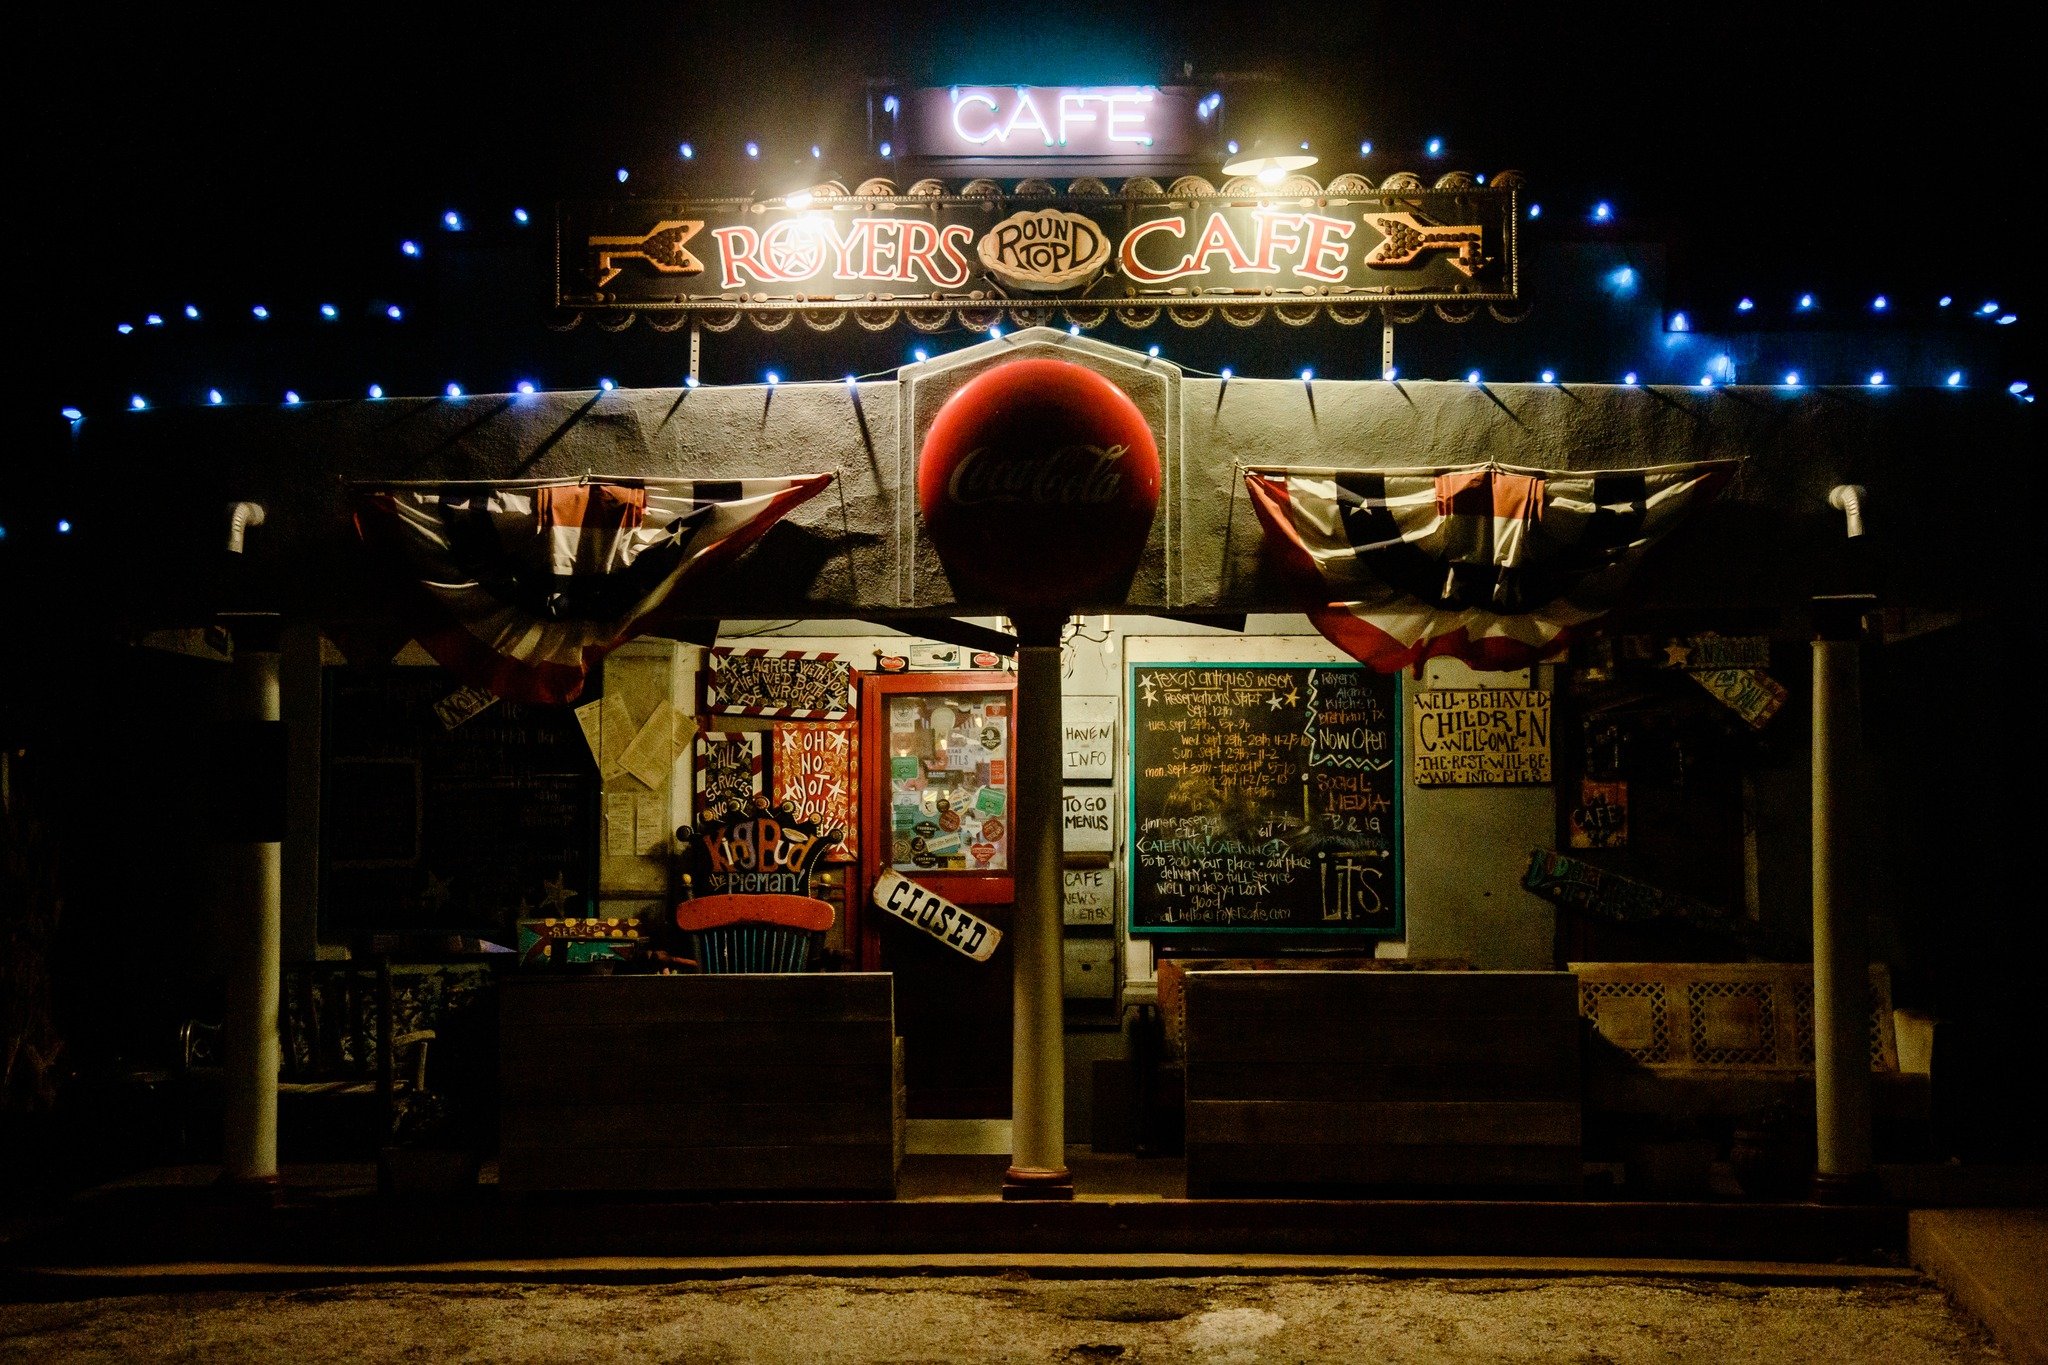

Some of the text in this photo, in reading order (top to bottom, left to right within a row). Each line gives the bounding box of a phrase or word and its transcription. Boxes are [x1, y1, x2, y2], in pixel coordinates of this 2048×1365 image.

[953, 94, 1153, 146] CAFE
[711, 218, 974, 289] ROYERS
[996, 217, 1099, 271] ROUND
[1118, 211, 1356, 284] CAFE
[1020, 242, 1071, 273] TOP
[753, 658, 796, 673] AGREE
[766, 684, 815, 710] WRONG
[1468, 691, 1547, 709] BEHAVED
[803, 731, 824, 752] OH
[1065, 725, 1110, 741] HAVEN
[1420, 708, 1548, 752] CHILDREN
[1442, 728, 1519, 752] WELCOME
[718, 744, 740, 769] ALL
[801, 753, 823, 775] NO
[1067, 751, 1107, 767] INFO
[1419, 754, 1545, 770] THE REST WILL BE
[706, 774, 753, 802] SERVICES
[794, 773, 831, 799] NOT
[1420, 770, 1456, 783] MADE
[1466, 770, 1495, 782] INTO
[1062, 795, 1107, 812] TO GO
[1065, 815, 1109, 831] MENUS
[1064, 872, 1103, 887] CAFE
[887, 881, 987, 955] CLOSED
